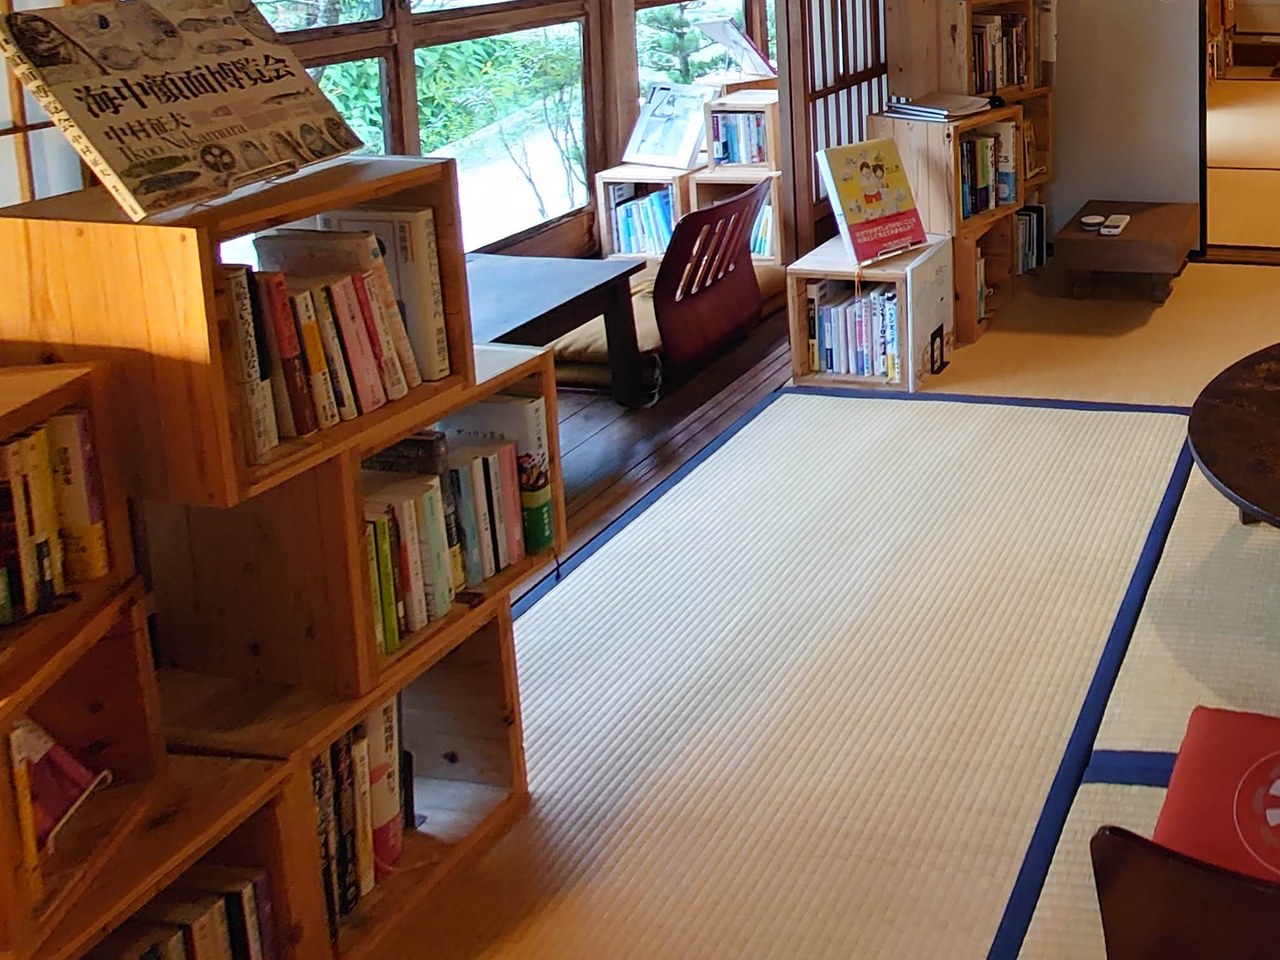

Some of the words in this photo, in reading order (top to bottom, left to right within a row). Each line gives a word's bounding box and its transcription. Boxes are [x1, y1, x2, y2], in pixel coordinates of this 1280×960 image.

[74, 53, 296, 119] 海中顔面博覧会
[104, 111, 192, 146] 中村征夫
